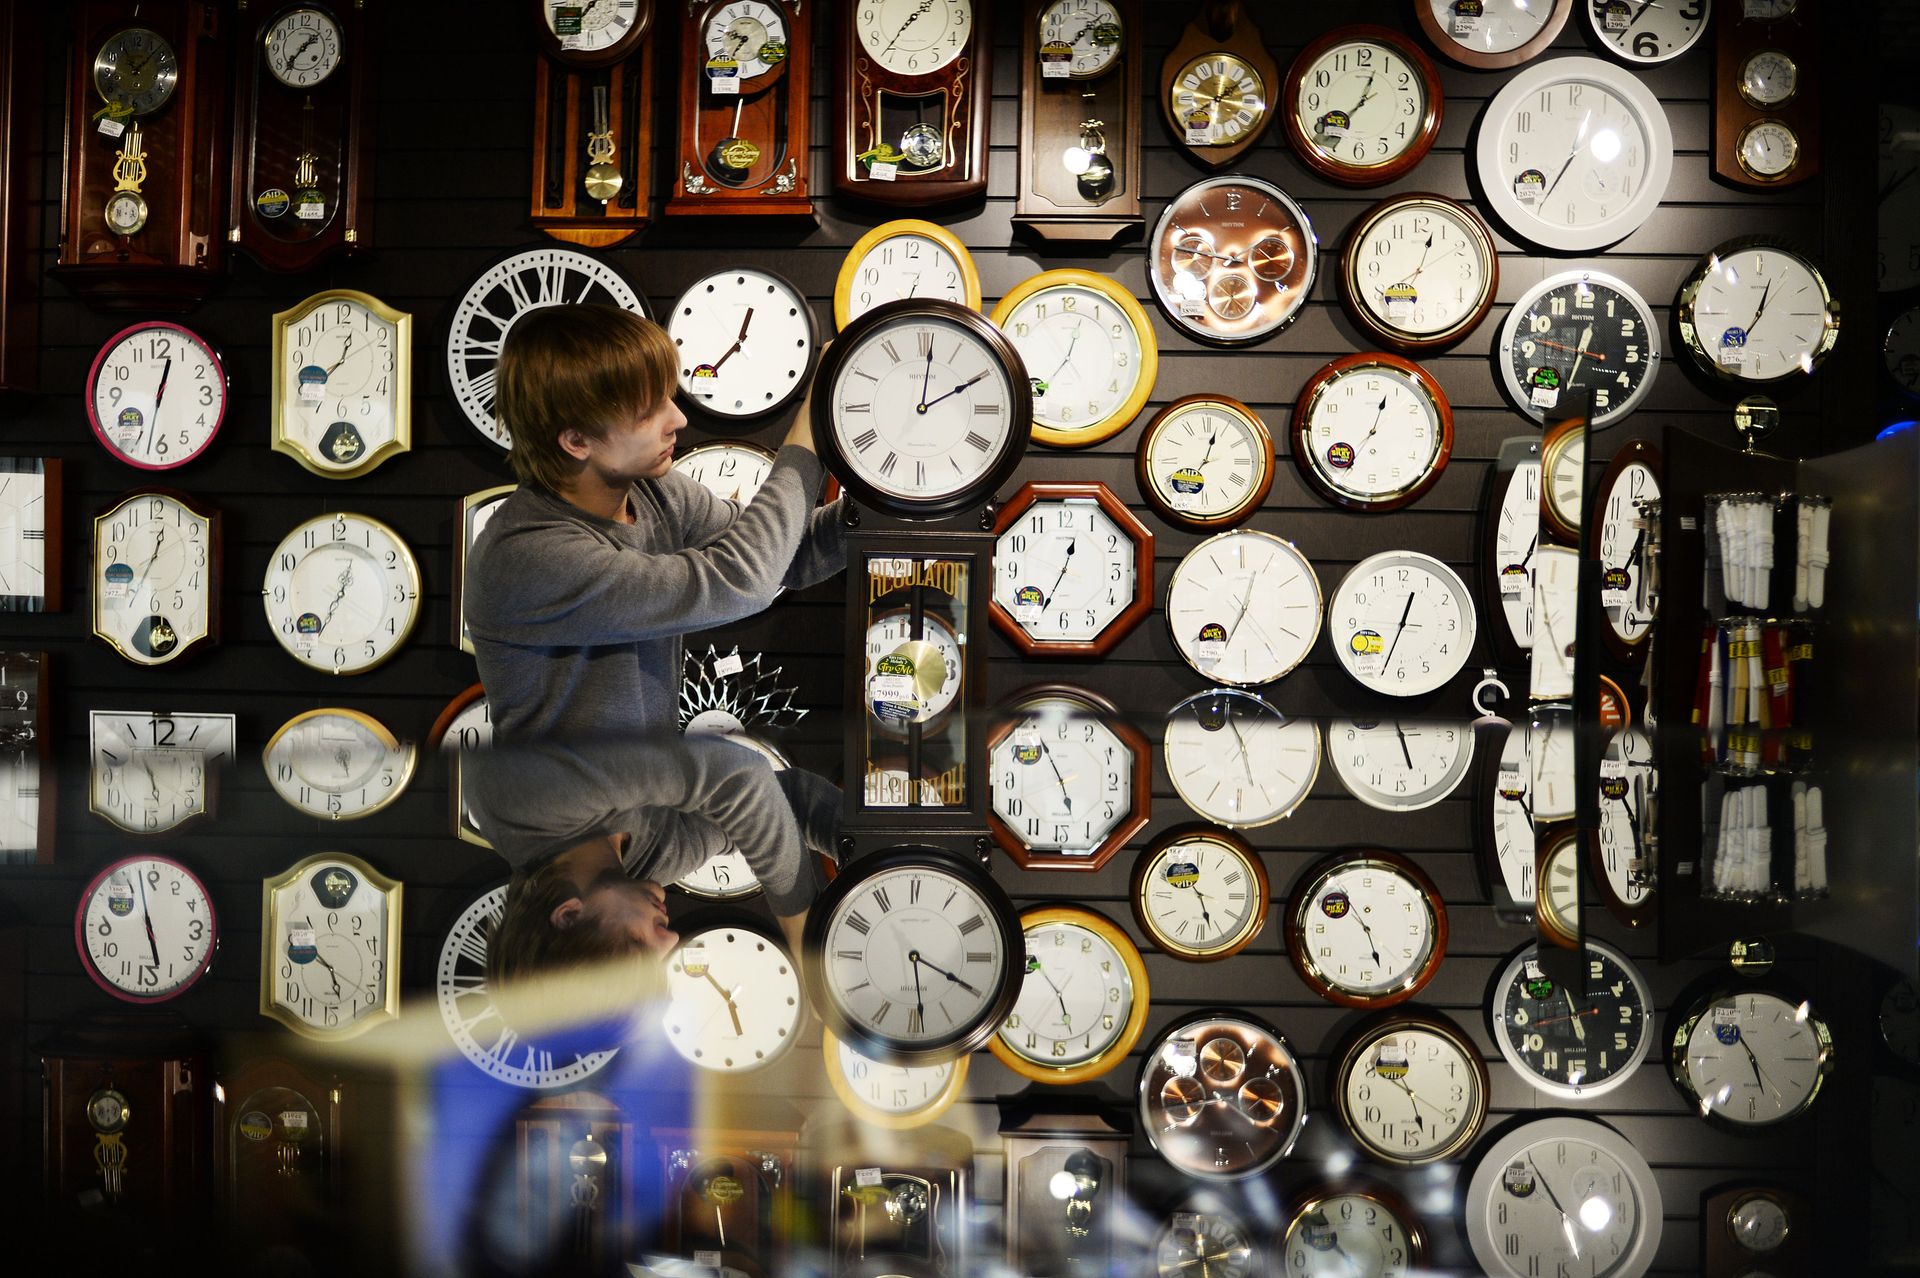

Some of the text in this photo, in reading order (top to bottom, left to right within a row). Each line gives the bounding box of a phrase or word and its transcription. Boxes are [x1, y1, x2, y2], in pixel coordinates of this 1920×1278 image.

[865, 10, 873, 25] 9
[955, 10, 964, 25] 3
[1680, 0, 1701, 20] 3
[300, 15, 311, 26] 12
[325, 29, 332, 40] 2
[948, 31, 956, 45] 4
[329, 43, 335, 55] 3
[1632, 32, 1660, 56] 6
[909, 54, 917, 69] 6
[931, 48, 939, 63] 5
[1336, 54, 1346, 71] 11
[1358, 49, 1372, 66] 12
[1386, 57, 1389, 73] 1
[1316, 70, 1330, 87] 10
[1398, 73, 1409, 91] 2
[1309, 93, 1319, 111] 9
[1541, 92, 1550, 112] 11
[1570, 86, 1582, 106] 12
[1404, 98, 1414, 115] 3
[1396, 122, 1405, 138] 4
[1518, 112, 1530, 133] 10
[1354, 142, 1364, 160] 6
[1378, 138, 1388, 154] 5
[1510, 143, 1518, 163] 9
[1393, 225, 1403, 239] 11
[1414, 217, 1429, 233] 12
[883, 248, 892, 264] 11
[906, 242, 919, 258] 12
[1375, 240, 1390, 256] 10
[865, 268, 879, 285] 10
[1369, 261, 1380, 278] 9
[947, 272, 956, 288] 2
[1062, 297, 1076, 312] 12
[1550, 298, 1565, 315] 11
[1575, 291, 1595, 309] 12
[1607, 300, 1614, 317] 1
[315, 313, 325, 332] 11
[337, 304, 351, 325] 12
[366, 313, 369, 332] 1
[1531, 316, 1551, 333] 10
[1621, 319, 1634, 336] 2
[299, 327, 311, 347] 10
[377, 327, 387, 347] 2
[917, 333, 933, 358] XII
[133, 348, 142, 363] 11
[151, 338, 171, 359] 12
[181, 348, 184, 362] 1
[881, 340, 901, 364] XI
[1522, 341, 1536, 358] 9
[293, 351, 303, 371] 9
[383, 350, 393, 372] 3
[115, 366, 129, 381] 10
[195, 365, 205, 379] 2
[854, 369, 878, 385] X
[1617, 372, 1629, 387] 4
[376, 376, 387, 396] 4
[1368, 381, 1379, 390] 12
[110, 387, 122, 407] 9
[199, 385, 213, 406] 3
[1596, 389, 1609, 406] 5
[337, 396, 347, 418] 6
[361, 396, 371, 415] 5
[846, 404, 870, 412] IX
[975, 405, 999, 414] III
[1327, 404, 1337, 413] 10
[195, 413, 205, 427] 4
[155, 433, 168, 454] 6
[179, 430, 189, 445] 5
[853, 428, 877, 454] VIII
[965, 431, 991, 452] IIII
[719, 457, 736, 477] 12
[879, 451, 897, 477] VII
[949, 456, 962, 475] V
[916, 461, 926, 485] VI
[1630, 469, 1645, 500] 12
[150, 500, 163, 520] 12
[1610, 496, 1620, 520] 11
[129, 509, 138, 527] 11
[1031, 517, 1043, 533] 11
[1059, 511, 1073, 528] 12
[1090, 515, 1094, 532] 1
[113, 523, 125, 542] 10
[189, 523, 199, 543] 2
[305, 531, 314, 548] 11
[332, 521, 346, 541] 12
[367, 530, 369, 548] 1
[1604, 524, 1615, 542] 10
[1011, 535, 1025, 552] 10
[1108, 535, 1117, 553] 2
[282, 554, 296, 571] 10
[385, 551, 396, 569] 2
[1009, 561, 1017, 579] 9
[1111, 563, 1120, 581] 3
[1398, 570, 1409, 581] 12
[188, 571, 198, 590] 4
[870, 560, 967, 604] REGULATOR
[1373, 576, 1384, 587] 11
[150, 589, 160, 612] 6
[173, 590, 183, 610] 5
[274, 586, 285, 604] 9
[394, 584, 405, 603] 3
[1106, 588, 1116, 605] 4
[1356, 593, 1366, 604] 10
[1442, 594, 1449, 606] 2
[385, 617, 394, 635] 4
[1060, 612, 1068, 629] 6
[1086, 610, 1095, 626] 5
[1349, 618, 1356, 629] 9
[1448, 620, 1455, 631] 3
[334, 647, 345, 665] 6
[365, 639, 375, 657] 5
[1440, 644, 1447, 655] 4
[878, 662, 913, 674] Try Me
[1397, 667, 1405, 678] 6
[1423, 662, 1429, 673] 5
[877, 690, 899, 698] 7999
[149, 720, 176, 745] 12
